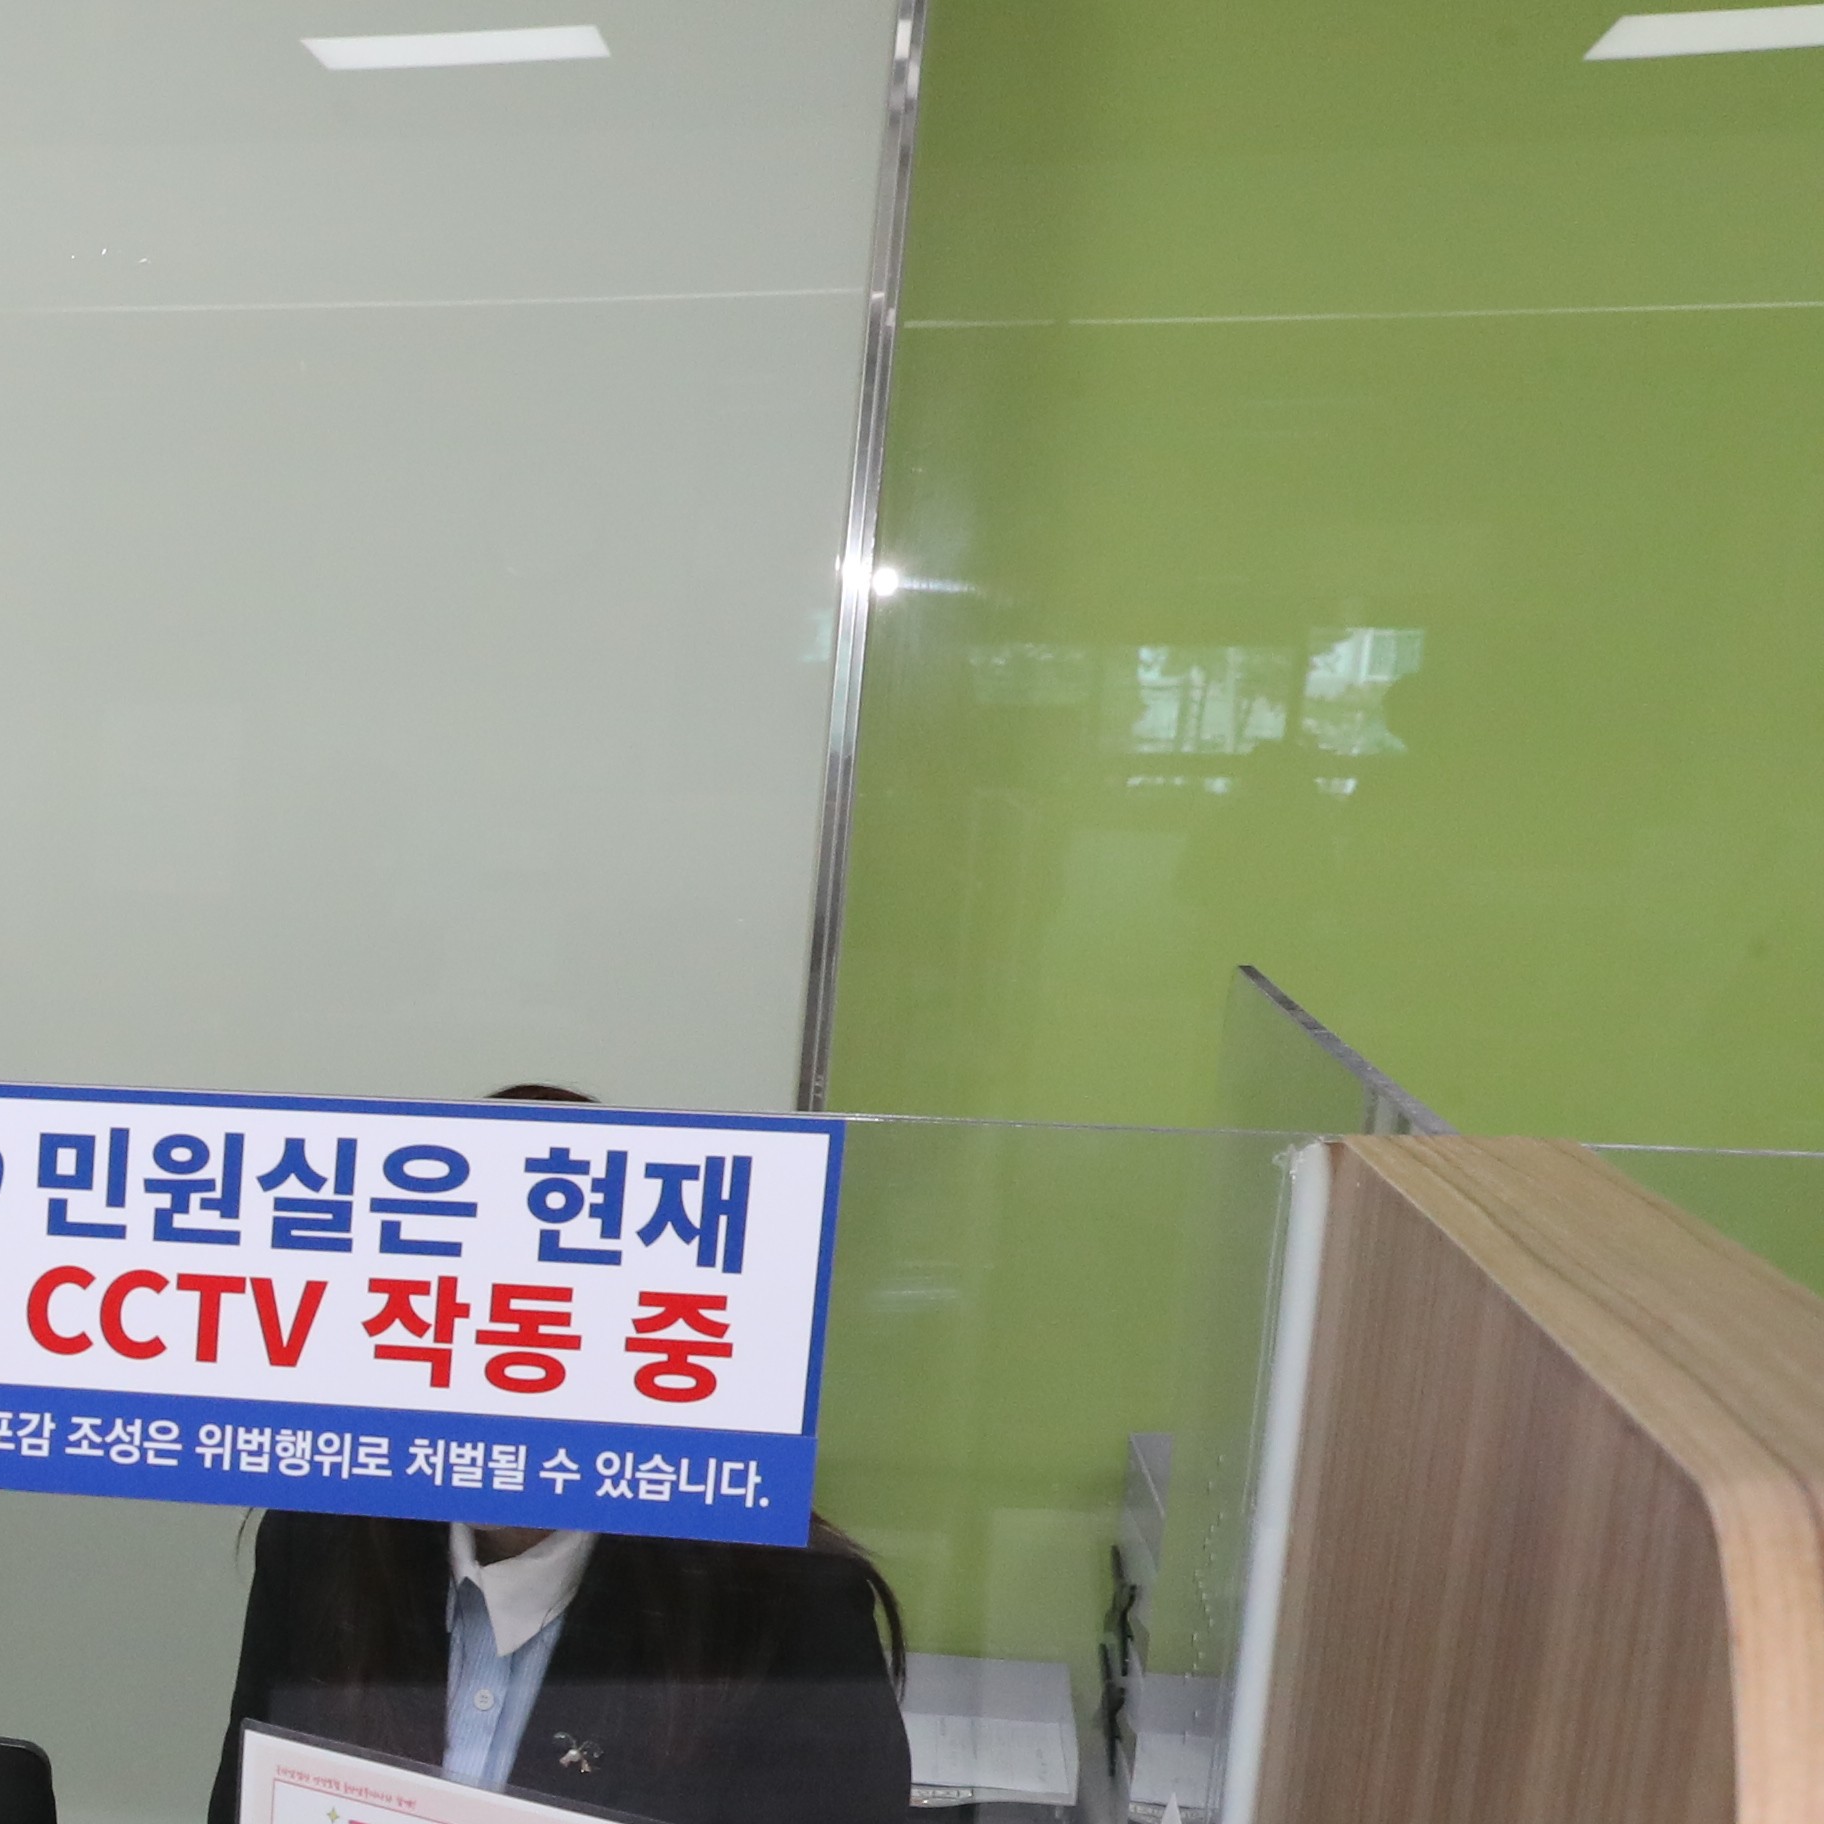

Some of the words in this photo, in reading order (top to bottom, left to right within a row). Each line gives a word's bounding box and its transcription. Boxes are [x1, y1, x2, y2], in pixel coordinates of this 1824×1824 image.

[38, 1128, 477, 1257] 민원실은
[525, 1147, 752, 1274] 현재
[27, 1266, 327, 1367] CCTV
[362, 1276, 581, 1393] 작동
[625, 1291, 733, 1403] 중
[65, 1417, 182, 1465] 조성은
[195, 1424, 392, 1479] 위법행위로
[406, 1439, 526, 1490] 처벌될
[540, 1449, 580, 1494] 수
[596, 1452, 768, 1507] 있습니다.
